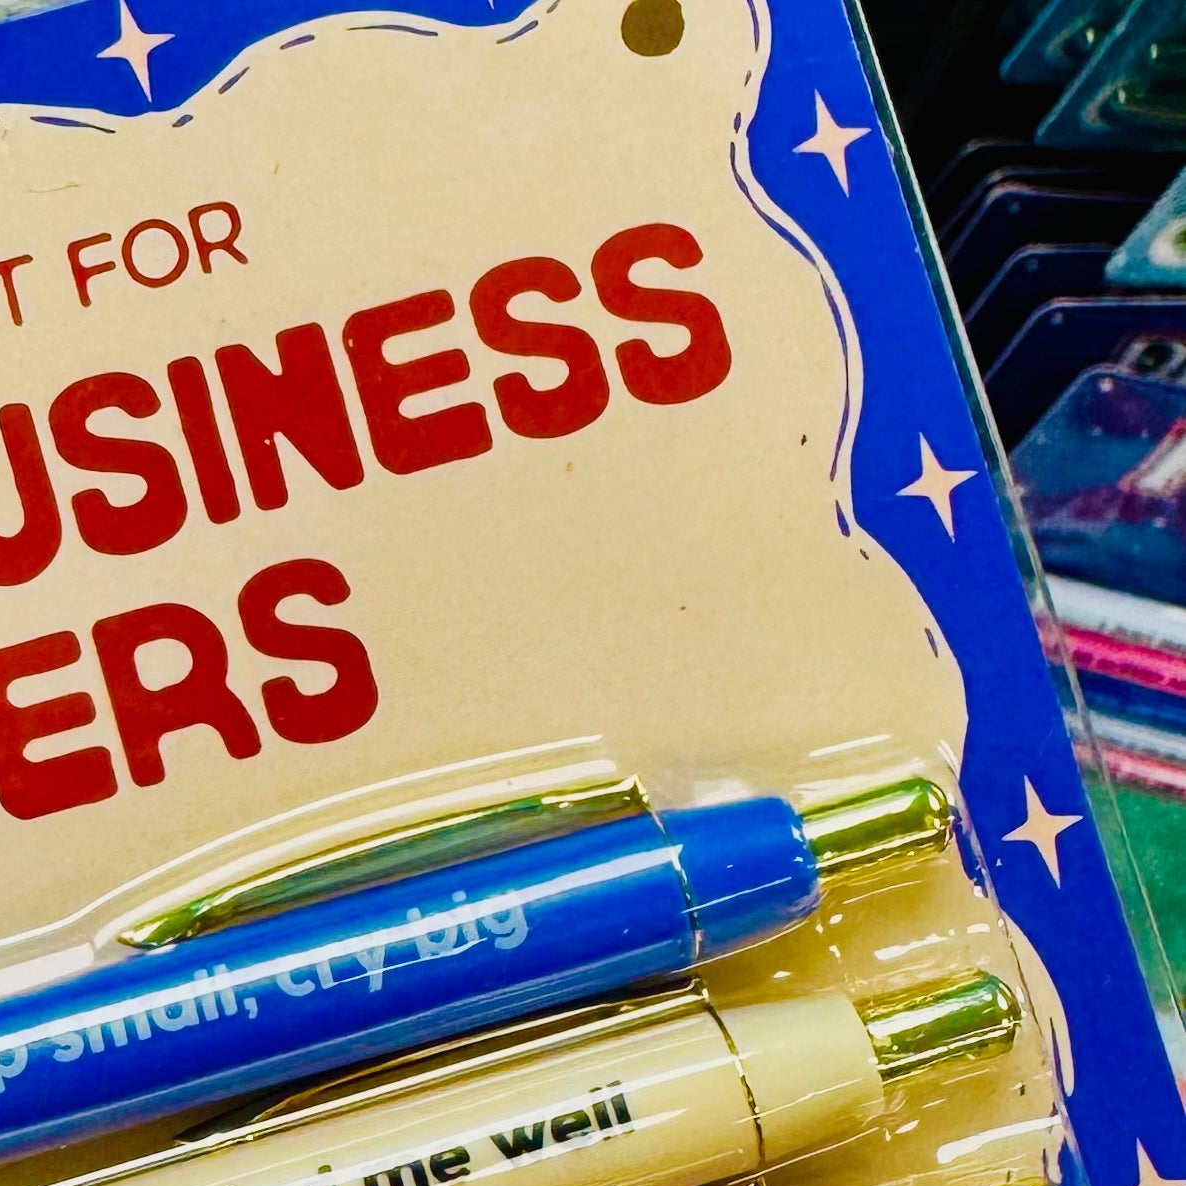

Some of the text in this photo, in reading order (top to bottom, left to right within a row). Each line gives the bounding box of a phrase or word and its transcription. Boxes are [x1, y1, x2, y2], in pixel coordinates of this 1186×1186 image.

[66, 202, 248, 308] FOR
[54, 967, 259, 1062] small,
[275, 940, 389, 993] cry
[405, 891, 531, 962] big
[488, 1080, 636, 1164] well
